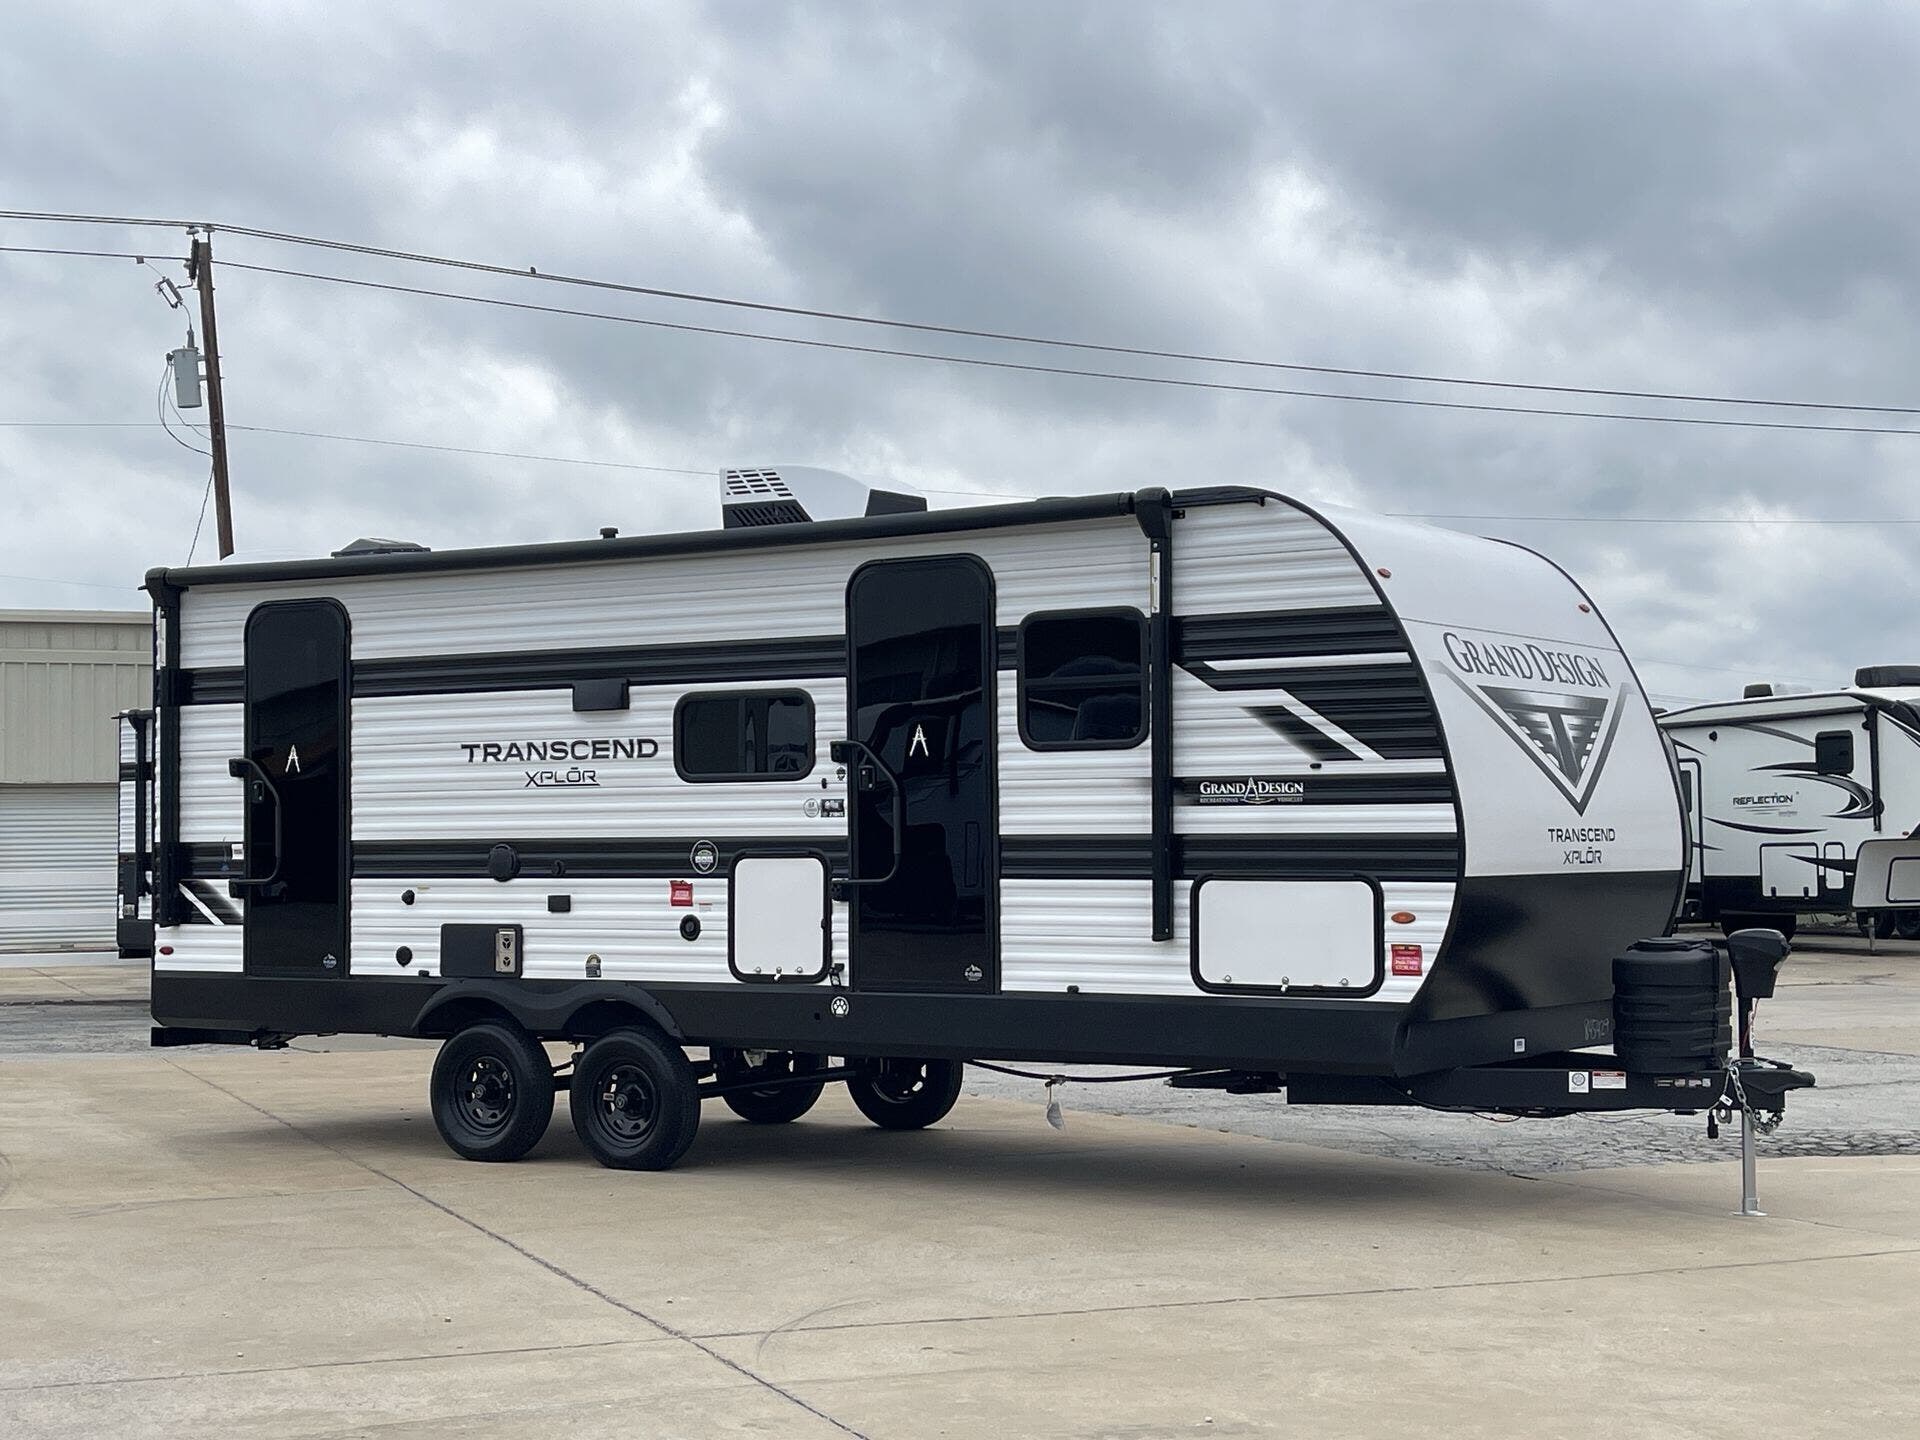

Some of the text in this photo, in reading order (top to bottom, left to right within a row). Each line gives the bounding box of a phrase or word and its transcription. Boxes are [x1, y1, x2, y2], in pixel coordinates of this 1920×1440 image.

[1443, 632, 1611, 688] GRAND DESIGN
[461, 738, 659, 763] TRANSCEND
[1200, 781, 1303, 794] GRAND DESIGN
[1732, 793, 1793, 806] REFLECTION
[1548, 828, 1616, 842] TRANSCEND
